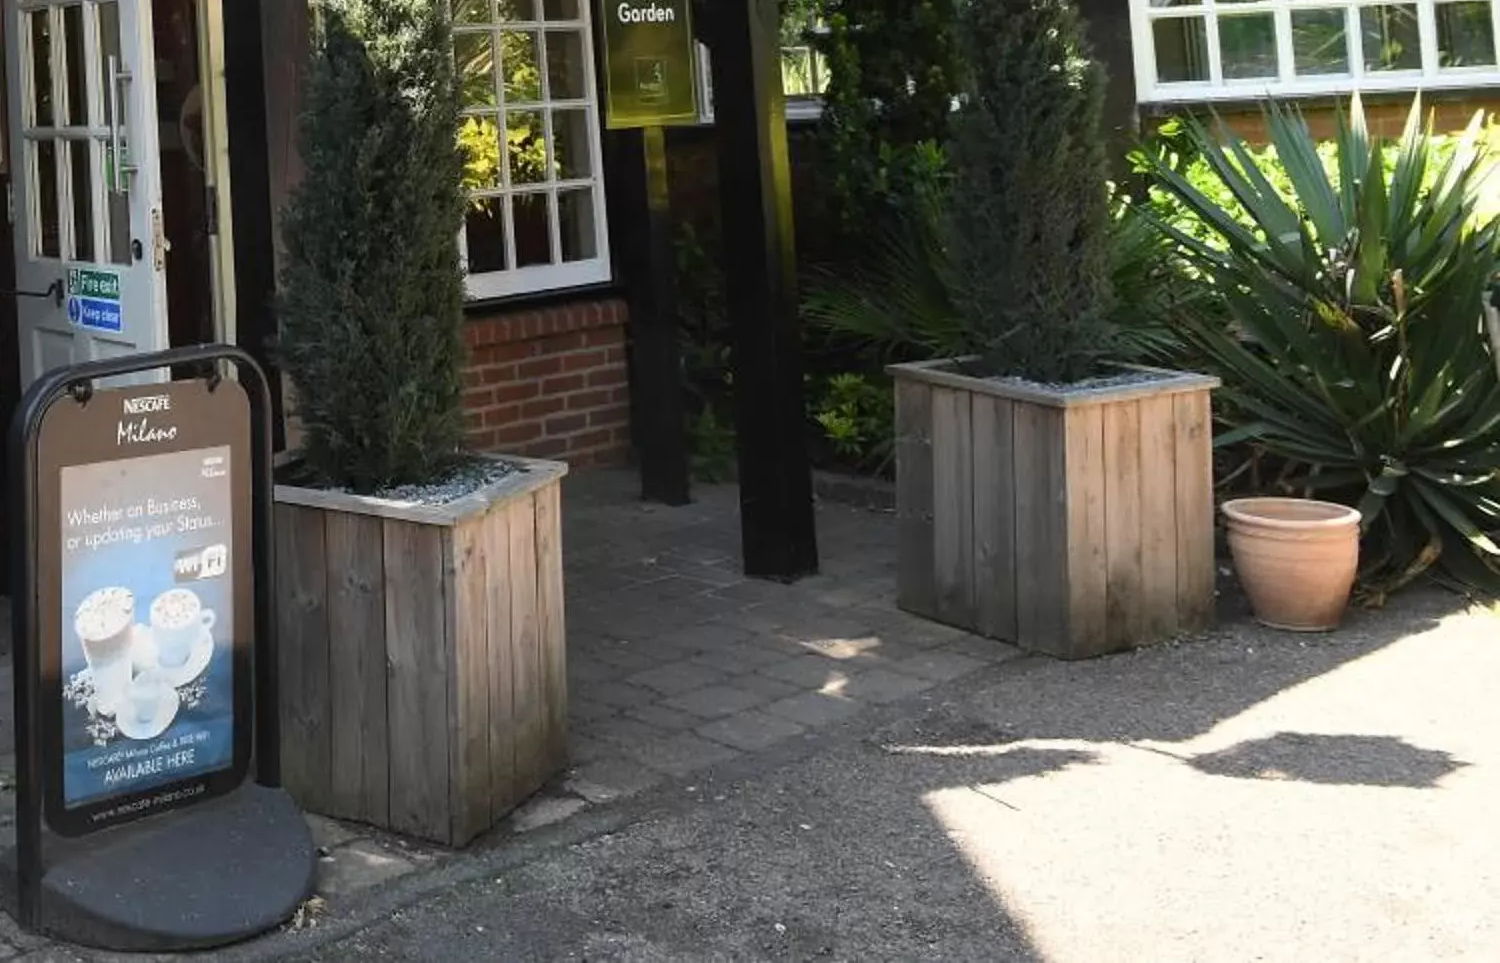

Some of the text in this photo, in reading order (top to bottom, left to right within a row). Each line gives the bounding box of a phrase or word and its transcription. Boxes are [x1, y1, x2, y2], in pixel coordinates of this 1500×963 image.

[617, 1, 675, 23] Garden
[117, 417, 177, 445] Milano
[67, 503, 124, 526] Whether
[127, 505, 144, 518] on
[67, 538, 81, 550] or
[84, 525, 143, 551] updating
[145, 521, 173, 541] your
[104, 756, 163, 783] AVAILABLE
[167, 748, 196, 769] HERE
